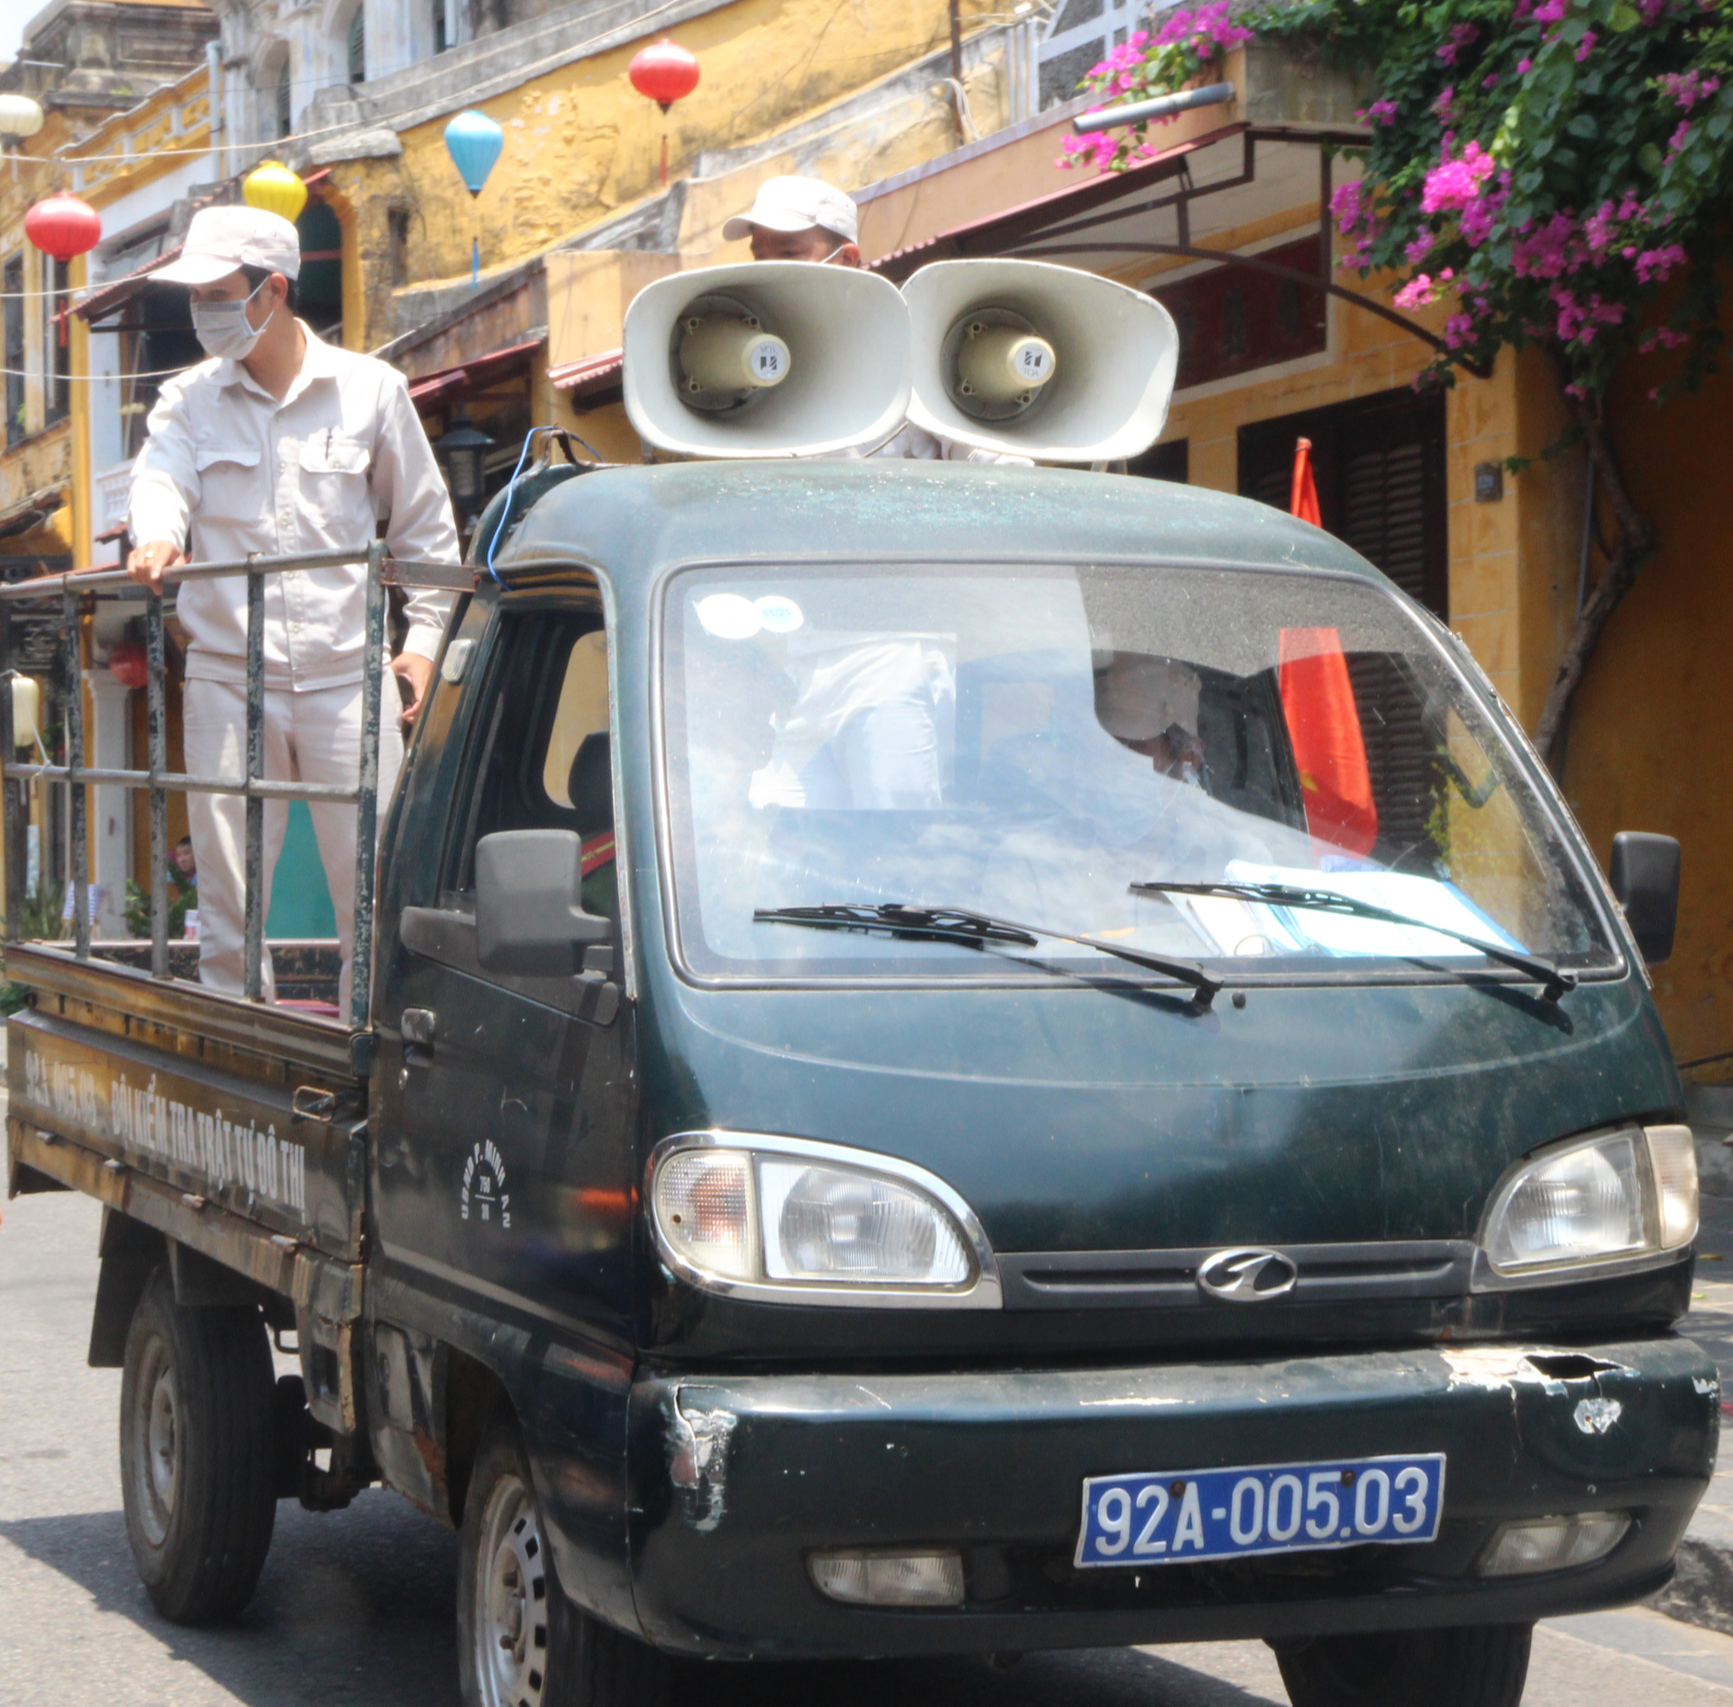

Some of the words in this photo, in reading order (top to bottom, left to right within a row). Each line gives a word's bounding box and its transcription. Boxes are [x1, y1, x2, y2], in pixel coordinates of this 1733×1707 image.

[1023, 366, 1040, 378] TOA
[169, 1100, 198, 1166] TRA
[197, 1108, 232, 1190] TRẬT
[234, 1119, 255, 1204] TỰ
[257, 1123, 278, 1200] ĐÔ
[280, 1139, 305, 1225] THỊ
[501, 1194, 511, 1228] AN
[1095, 1466, 1429, 1556] 92A-005.03
